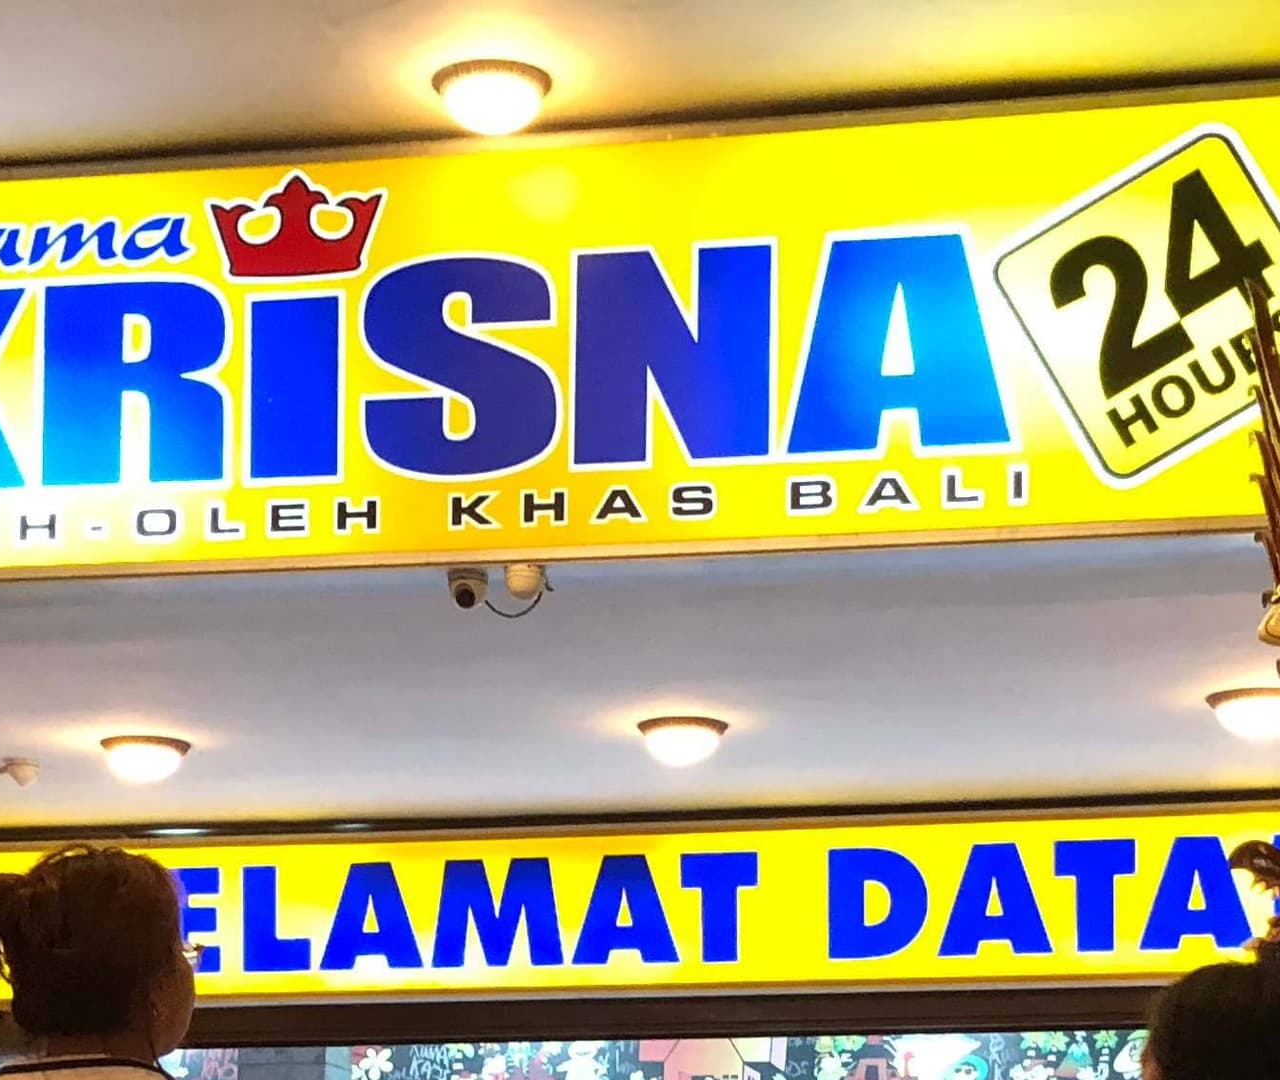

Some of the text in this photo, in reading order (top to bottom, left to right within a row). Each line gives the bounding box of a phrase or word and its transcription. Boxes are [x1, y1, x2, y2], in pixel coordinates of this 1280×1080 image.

[1049, 168, 1276, 398] 24
[451, 485, 715, 527] KHAS
[790, 470, 1026, 511] BALI
[176, 851, 759, 973] ELAMAT
